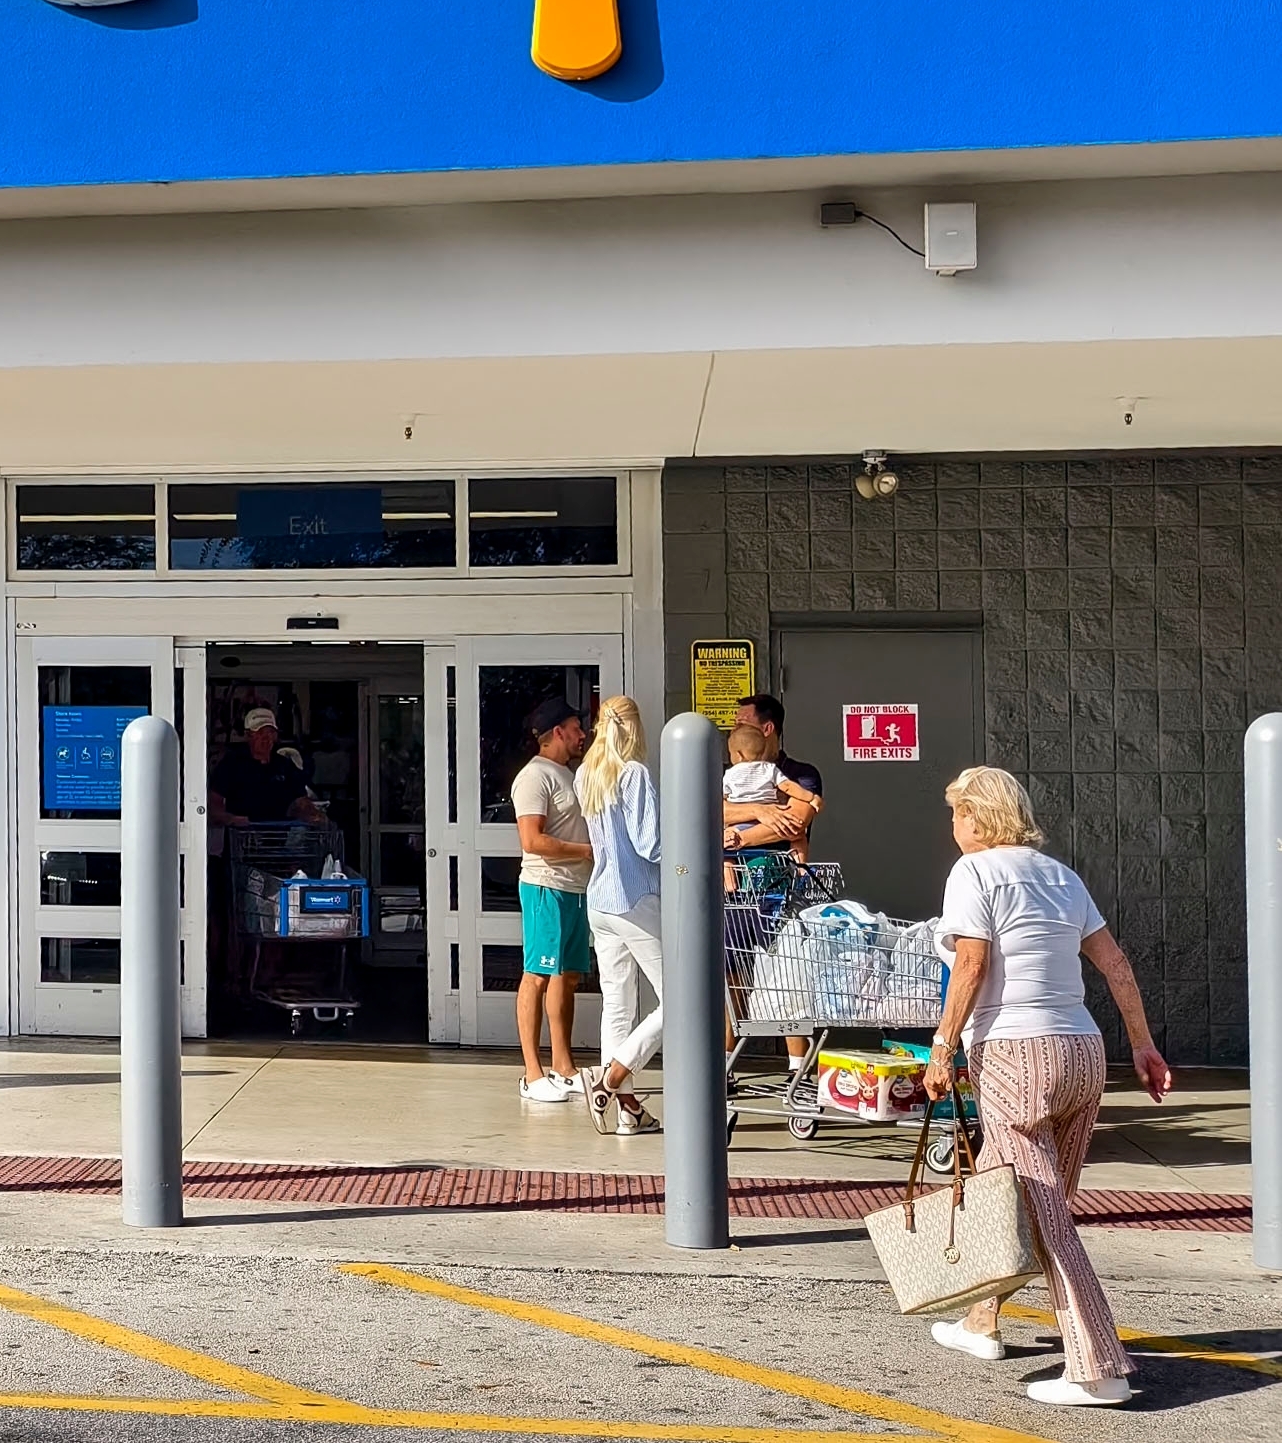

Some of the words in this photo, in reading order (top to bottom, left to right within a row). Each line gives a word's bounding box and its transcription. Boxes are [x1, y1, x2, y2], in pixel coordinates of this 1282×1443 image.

[289, 515, 329, 535] Exit
[697, 647, 747, 659] WARNING
[850, 706, 862, 714] DO
[863, 705, 880, 714] NOT
[882, 705, 910, 714] BLOCK
[852, 747, 878, 759] FIRE
[880, 747, 912, 759] EXITS
